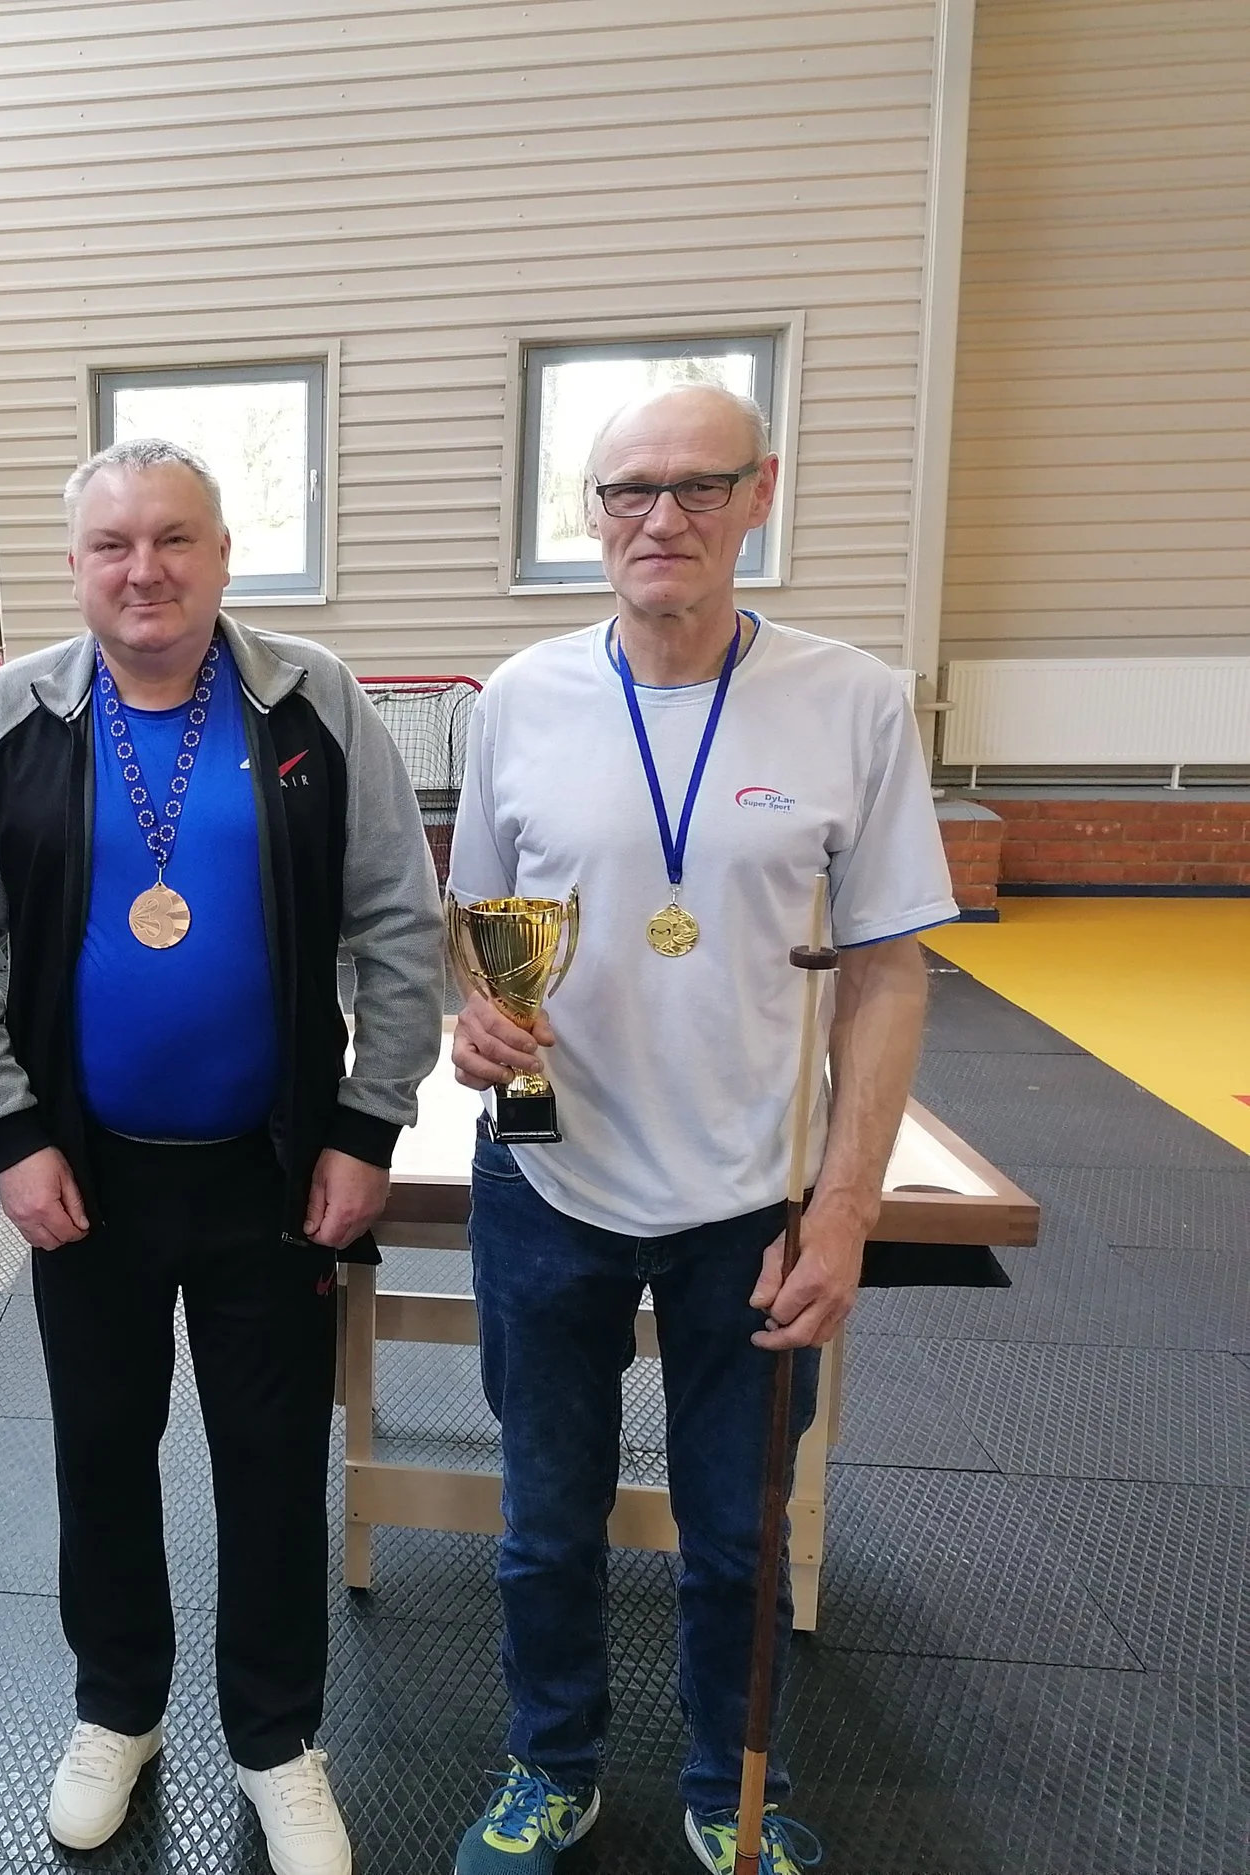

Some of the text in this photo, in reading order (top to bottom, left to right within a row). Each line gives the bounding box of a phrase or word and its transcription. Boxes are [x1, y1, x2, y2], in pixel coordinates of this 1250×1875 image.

[280, 774, 309, 788] AIR
[743, 799, 791, 812] Super Sport
[764, 793, 796, 805] DyLan
[131, 890, 175, 947] 3
